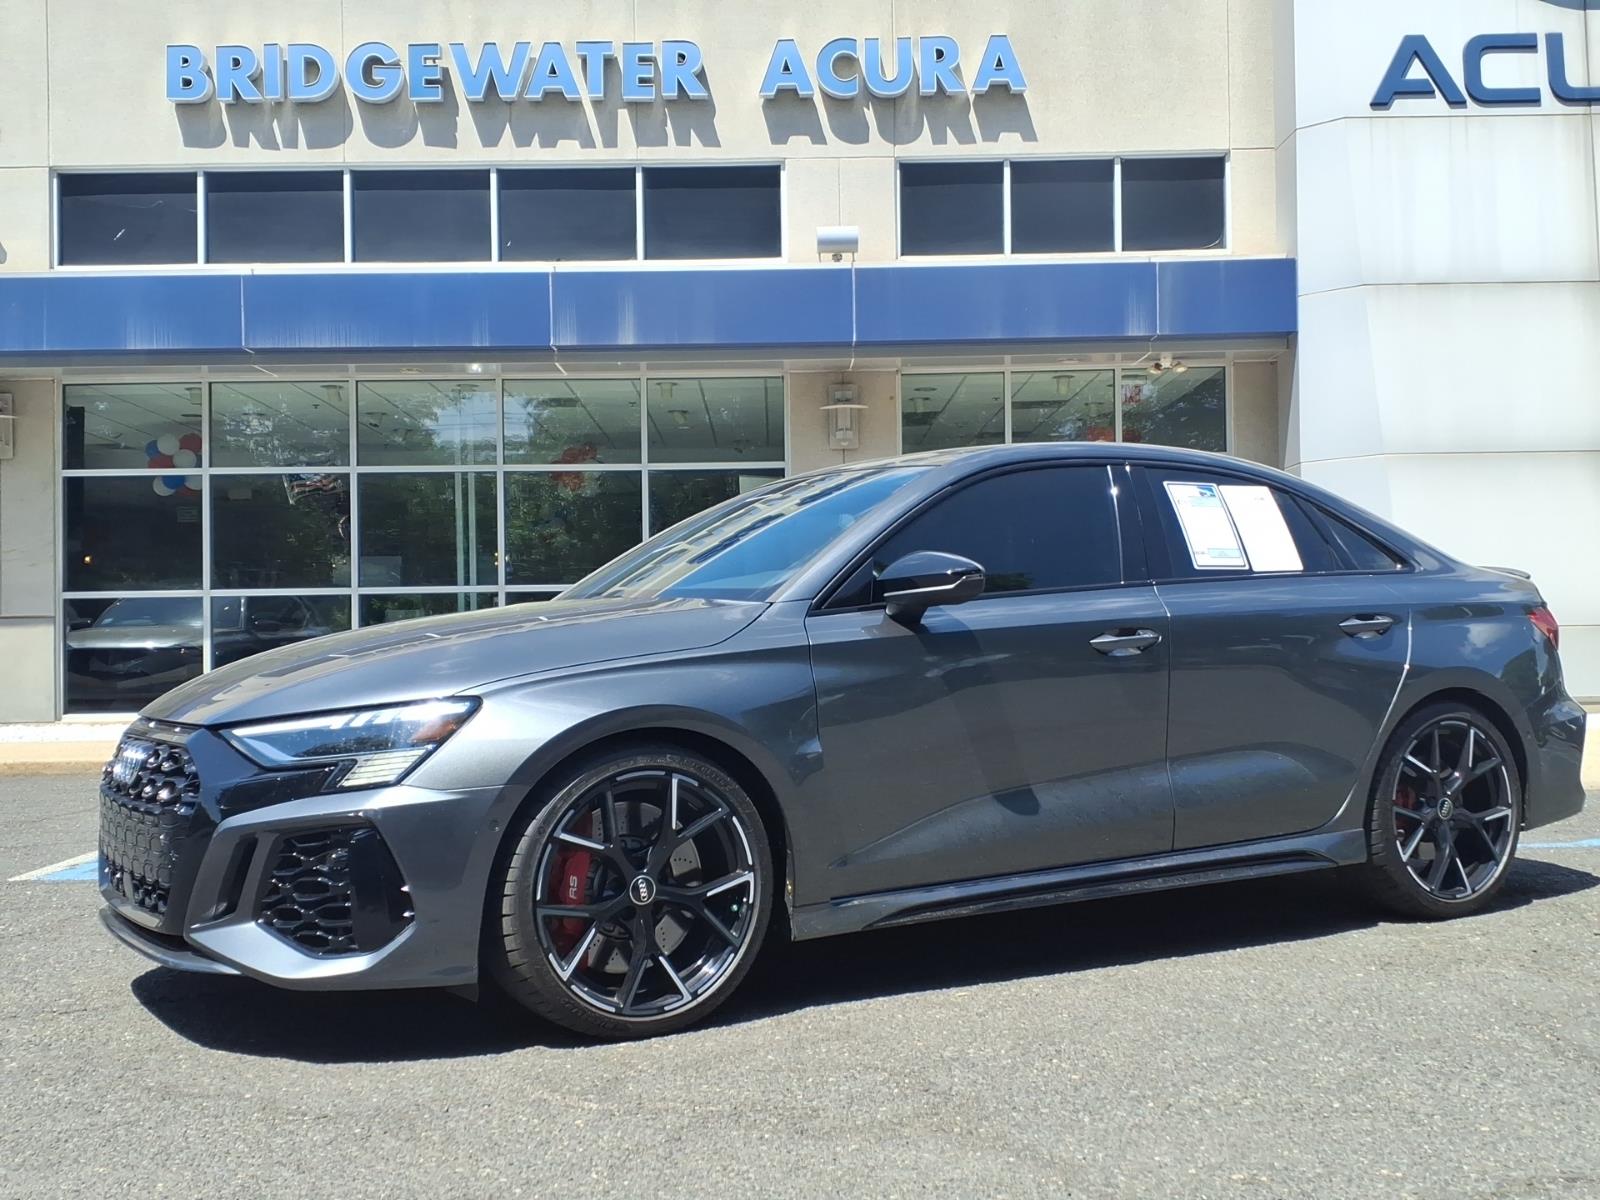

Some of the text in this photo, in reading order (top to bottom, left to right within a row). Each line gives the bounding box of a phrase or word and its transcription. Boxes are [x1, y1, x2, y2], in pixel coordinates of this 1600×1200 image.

[165, 34, 1028, 105] BRIDGEWATER ACURA
[1369, 32, 1600, 108] ACU
[568, 875, 578, 900] RS
